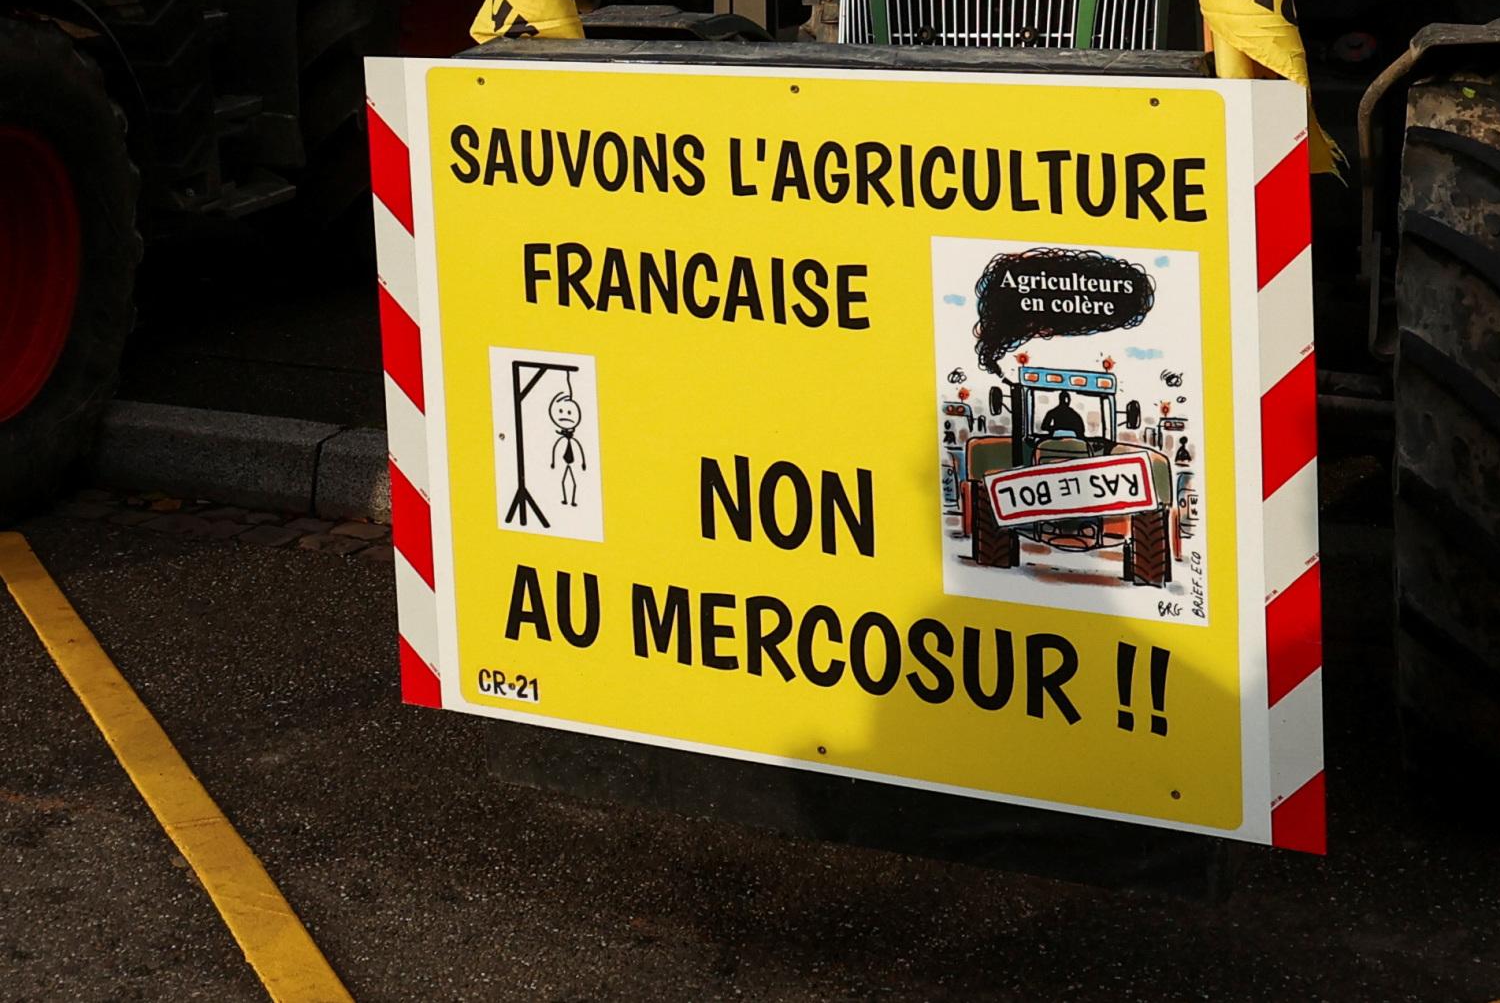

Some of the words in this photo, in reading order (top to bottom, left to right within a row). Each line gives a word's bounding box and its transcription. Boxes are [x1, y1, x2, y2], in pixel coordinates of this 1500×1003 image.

[451, 124, 706, 196] SAUVONS
[730, 137, 1208, 223] L'AGRICULTURE
[524, 242, 871, 330] FRANCAISE
[1000, 269, 1134, 295] Agriculteurs
[1021, 298, 1045, 312] en
[1051, 295, 1115, 316] colère
[998, 481, 1052, 507] BOL
[1058, 477, 1081, 496] LE
[1090, 473, 1139, 498] RAS
[700, 454, 875, 558] NON
[504, 564, 600, 648] AU
[632, 583, 1083, 726] MERCOSUR
[1116, 641, 1171, 737] !!
